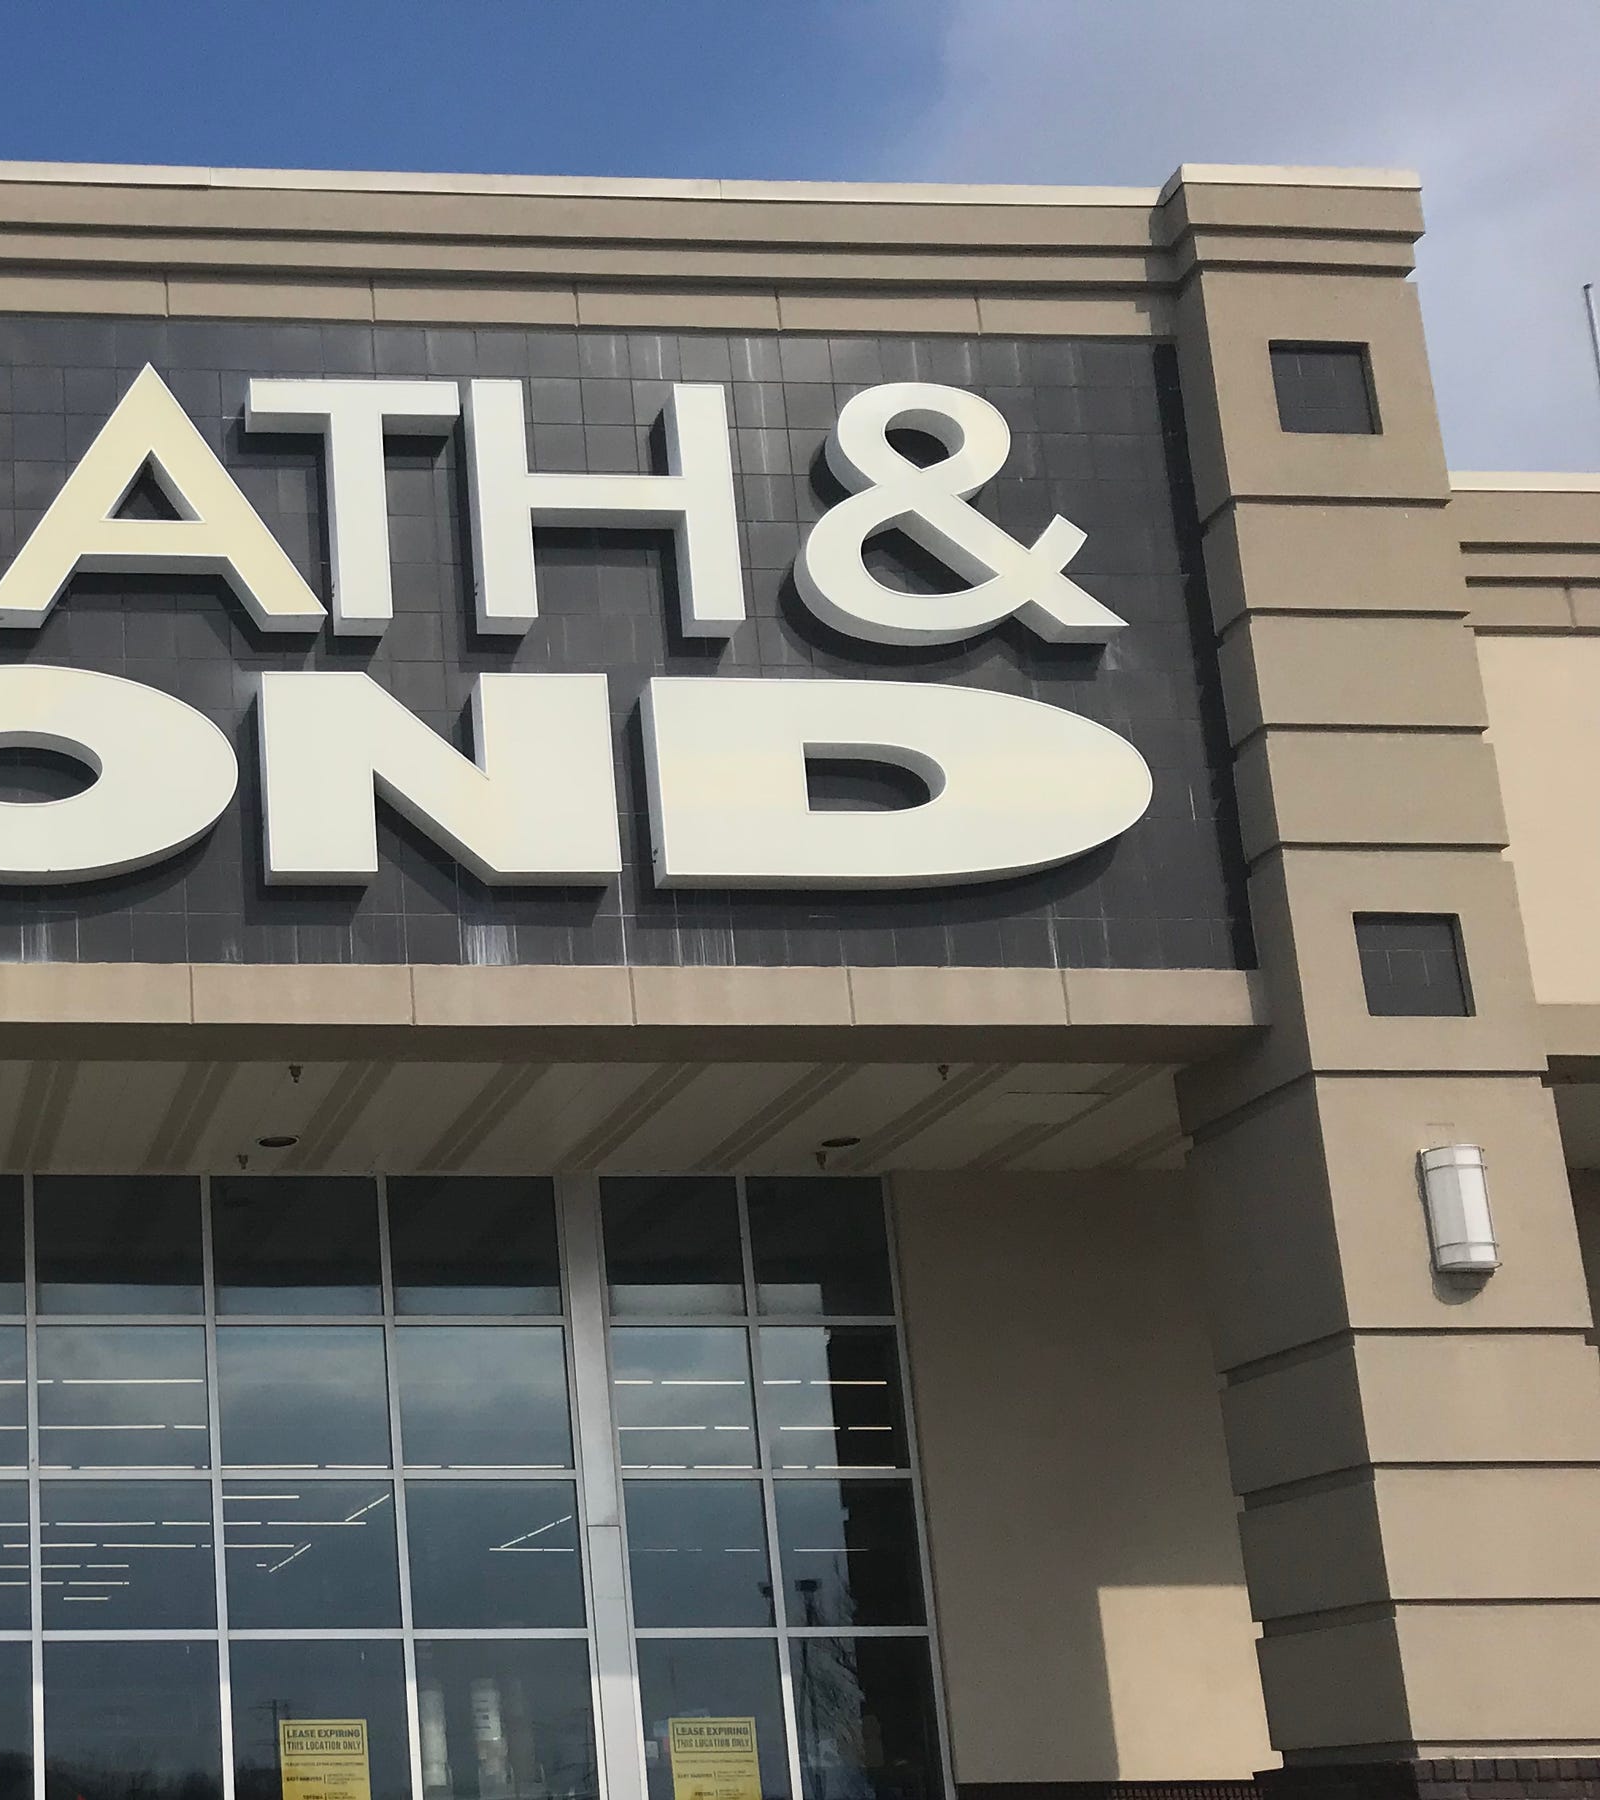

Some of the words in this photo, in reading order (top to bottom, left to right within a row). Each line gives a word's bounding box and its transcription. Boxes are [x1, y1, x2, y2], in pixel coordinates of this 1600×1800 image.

[795, 381, 1130, 646] &
[286, 1729, 316, 1739] LEASE
[317, 1728, 361, 1738] EXPIRING
[676, 1727, 705, 1736] LEASE
[706, 1727, 749, 1736] EXPIRING
[286, 1741, 304, 1751] THIS
[305, 1740, 341, 1751] LOCATION
[342, 1740, 361, 1750] ONLY
